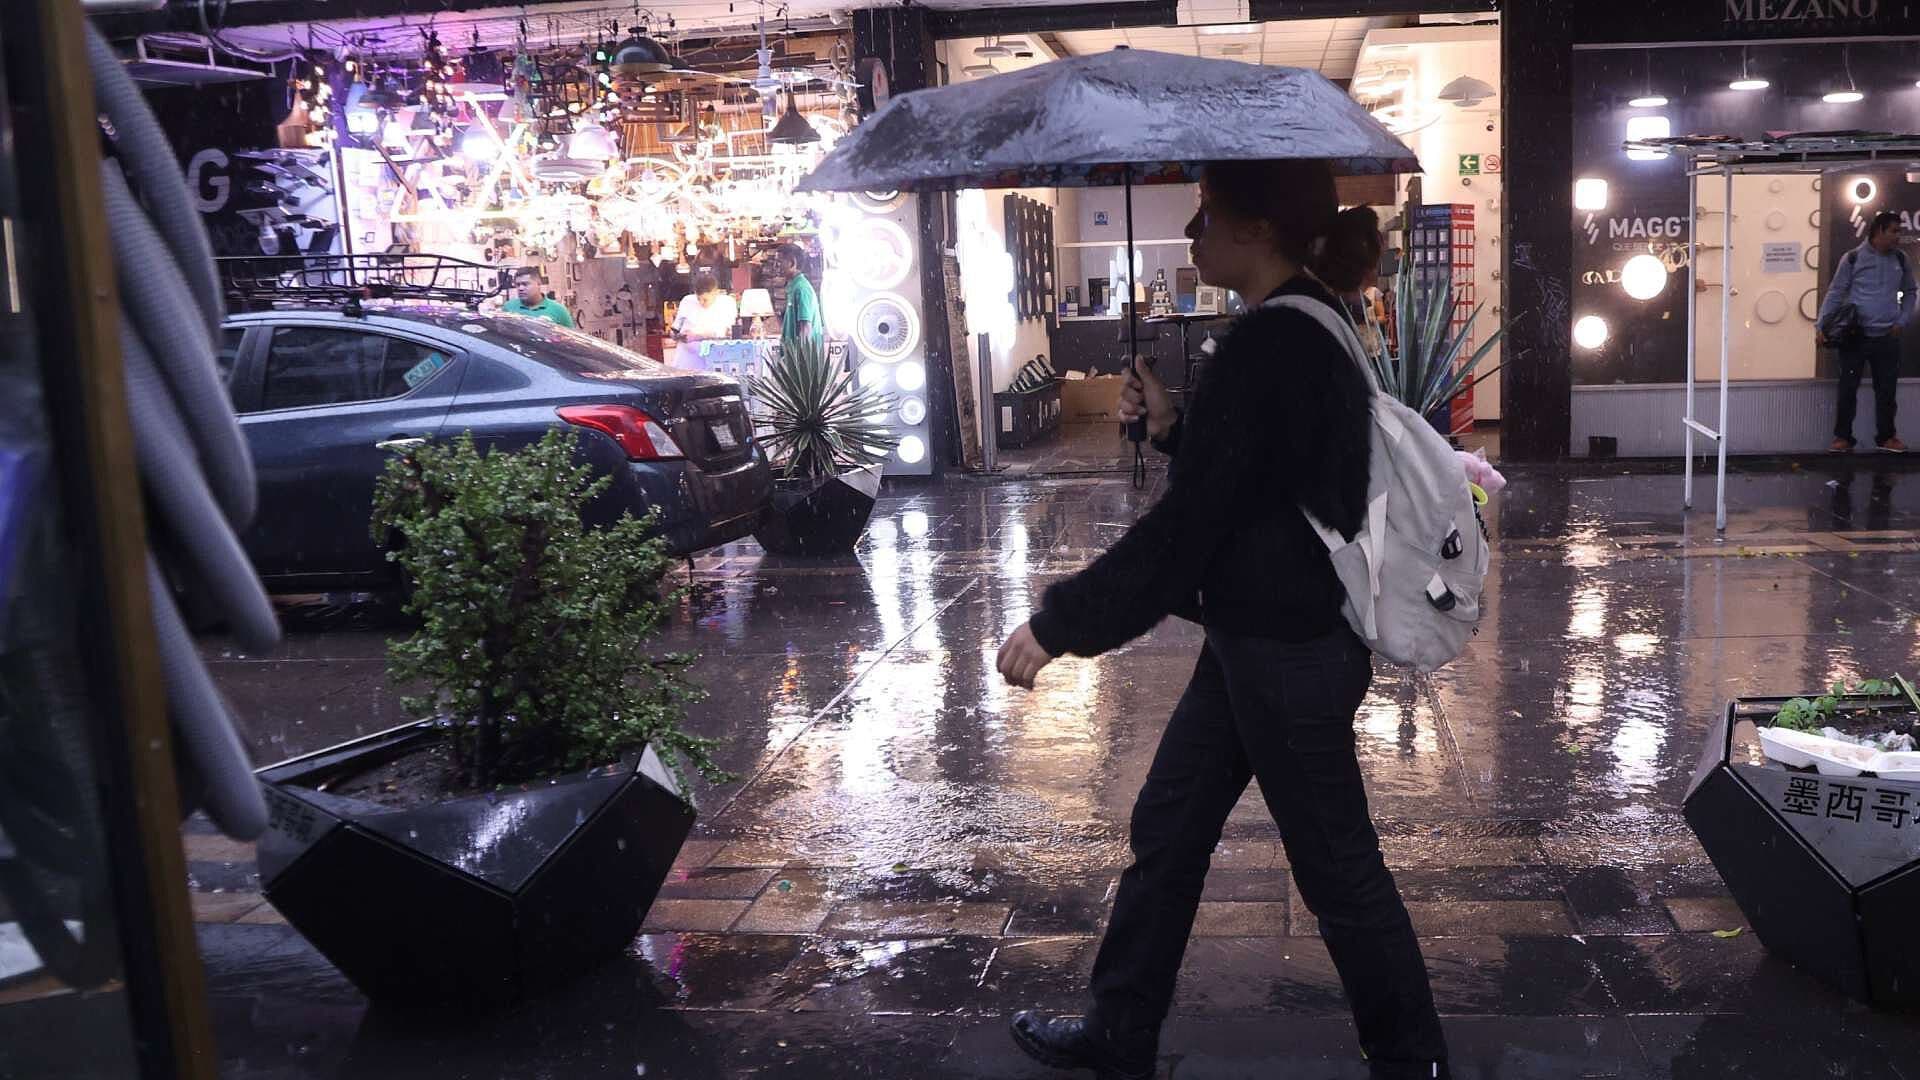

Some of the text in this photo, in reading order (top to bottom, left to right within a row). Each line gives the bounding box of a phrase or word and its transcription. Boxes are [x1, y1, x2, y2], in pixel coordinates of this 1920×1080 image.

[1722, 0, 1878, 22] MEZANO
[1608, 216, 1681, 239] MAGG
[1781, 776, 1920, 829] 墨西哥
